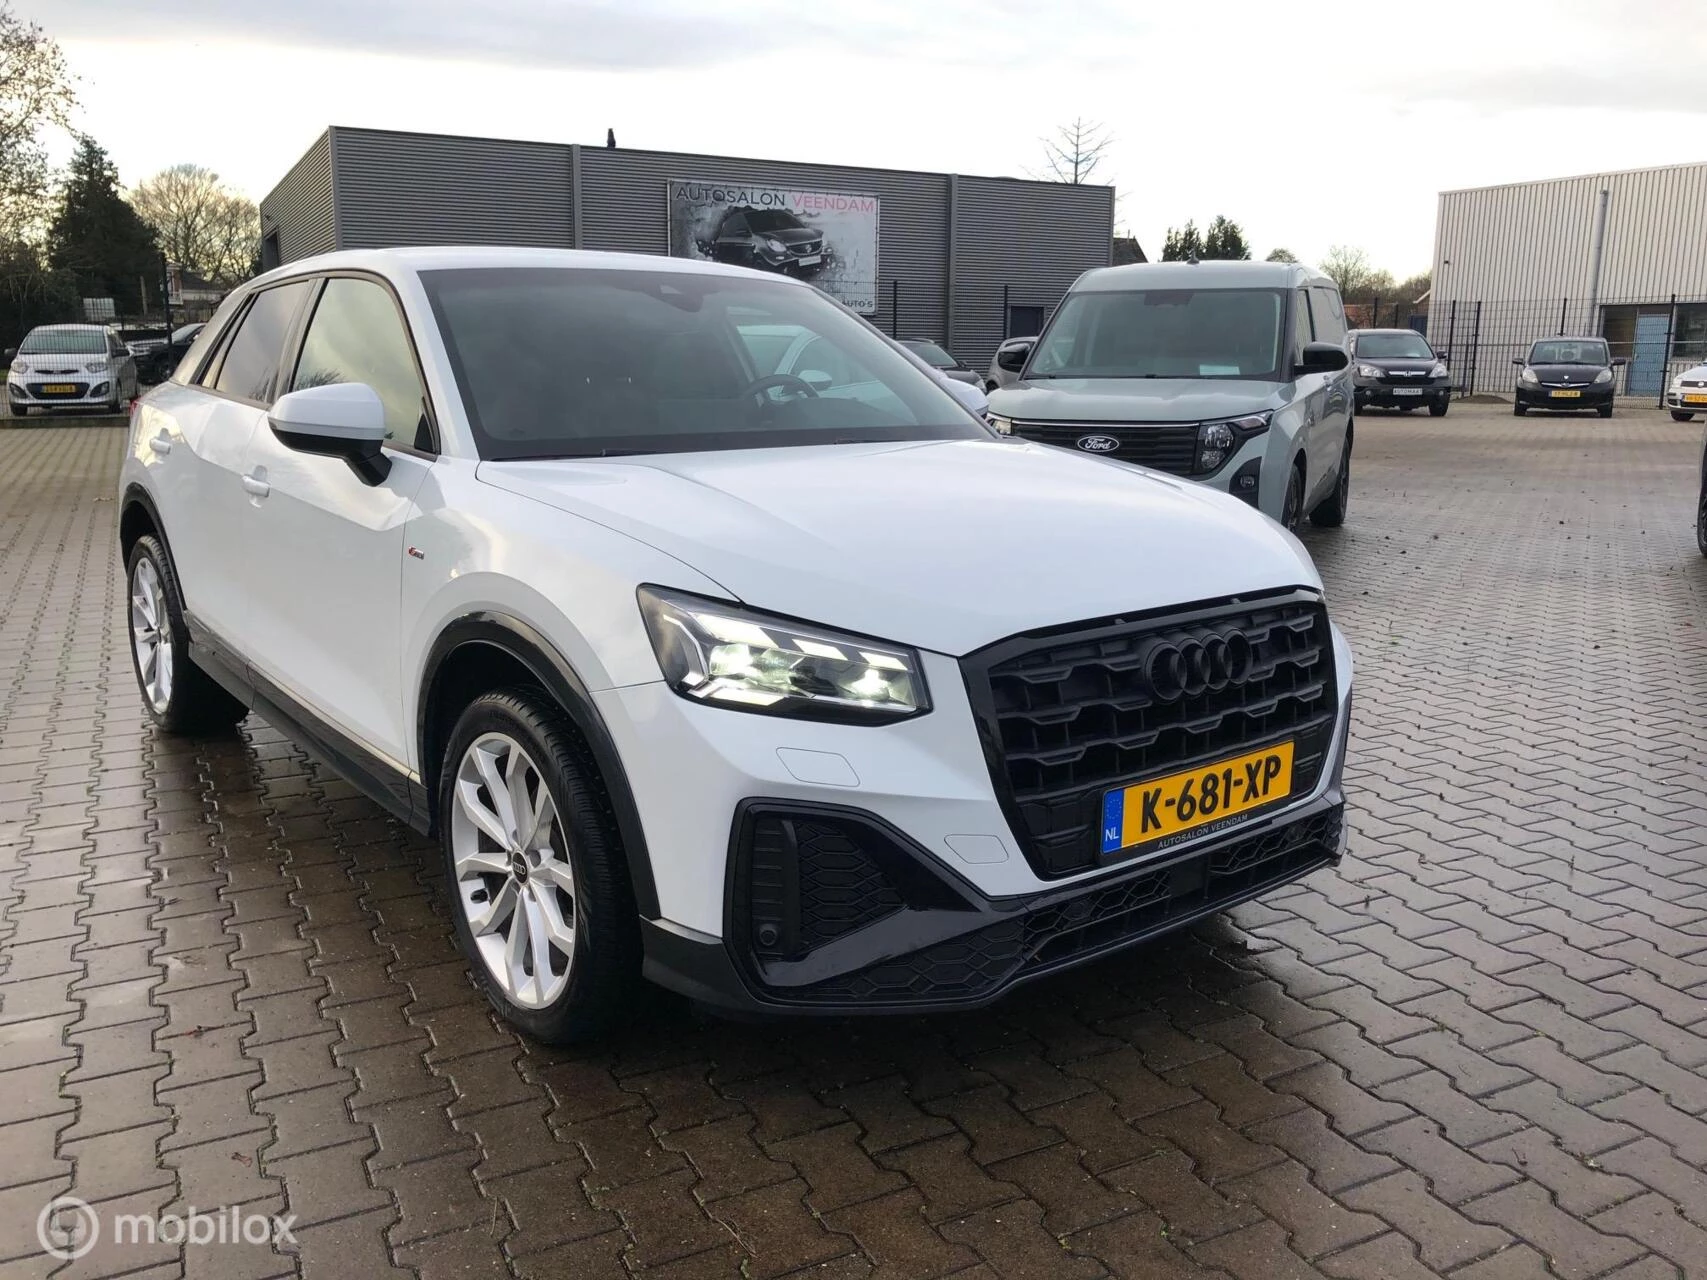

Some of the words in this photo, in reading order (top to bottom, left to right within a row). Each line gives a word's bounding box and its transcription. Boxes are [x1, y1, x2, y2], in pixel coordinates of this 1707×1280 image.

[676, 187, 785, 206] AUTOSALON
[792, 194, 874, 212] VEENDAM
[1084, 438, 1112, 450] Ford
[1141, 754, 1282, 834] K-681-XP
[1105, 827, 1119, 842] NL
[1157, 827, 1210, 849] AUTOSALON
[1211, 813, 1248, 832] VEENDAM
